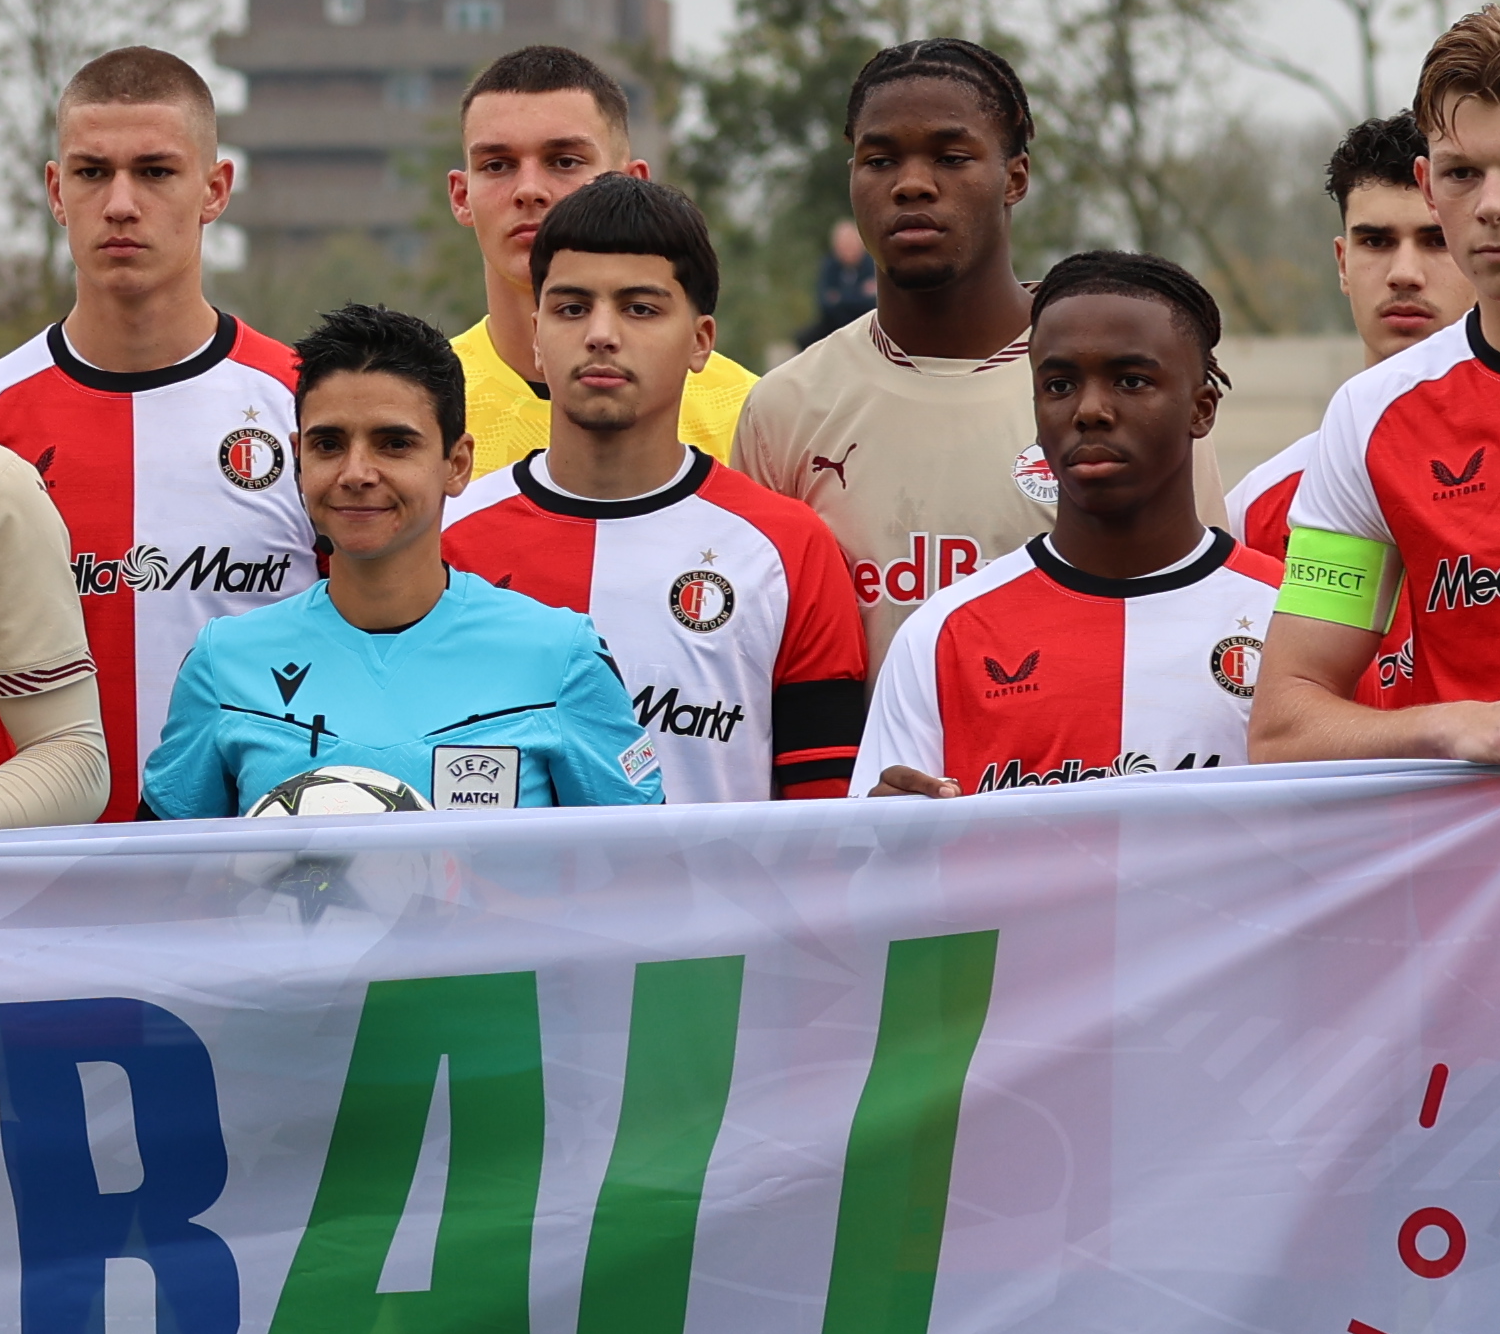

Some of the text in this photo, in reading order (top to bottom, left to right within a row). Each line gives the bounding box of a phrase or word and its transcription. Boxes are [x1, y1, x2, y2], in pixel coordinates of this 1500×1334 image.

[222, 428, 281, 451] FEYENOORD
[221, 463, 282, 489] ROTTERDAM
[1432, 482, 1487, 501] CASTORE
[161, 545, 292, 594] Markt
[1291, 563, 1366, 591] RESPECT
[675, 571, 732, 595] FEYENOORD
[672, 603, 731, 631] ROTTERDAM
[1215, 637, 1264, 655] FEYENOO
[985, 683, 1040, 699] CASTORE
[633, 684, 746, 743] Markt
[450, 758, 500, 780] UEFA
[624, 746, 656, 776] FOUN
[450, 792, 499, 804] MATCH
